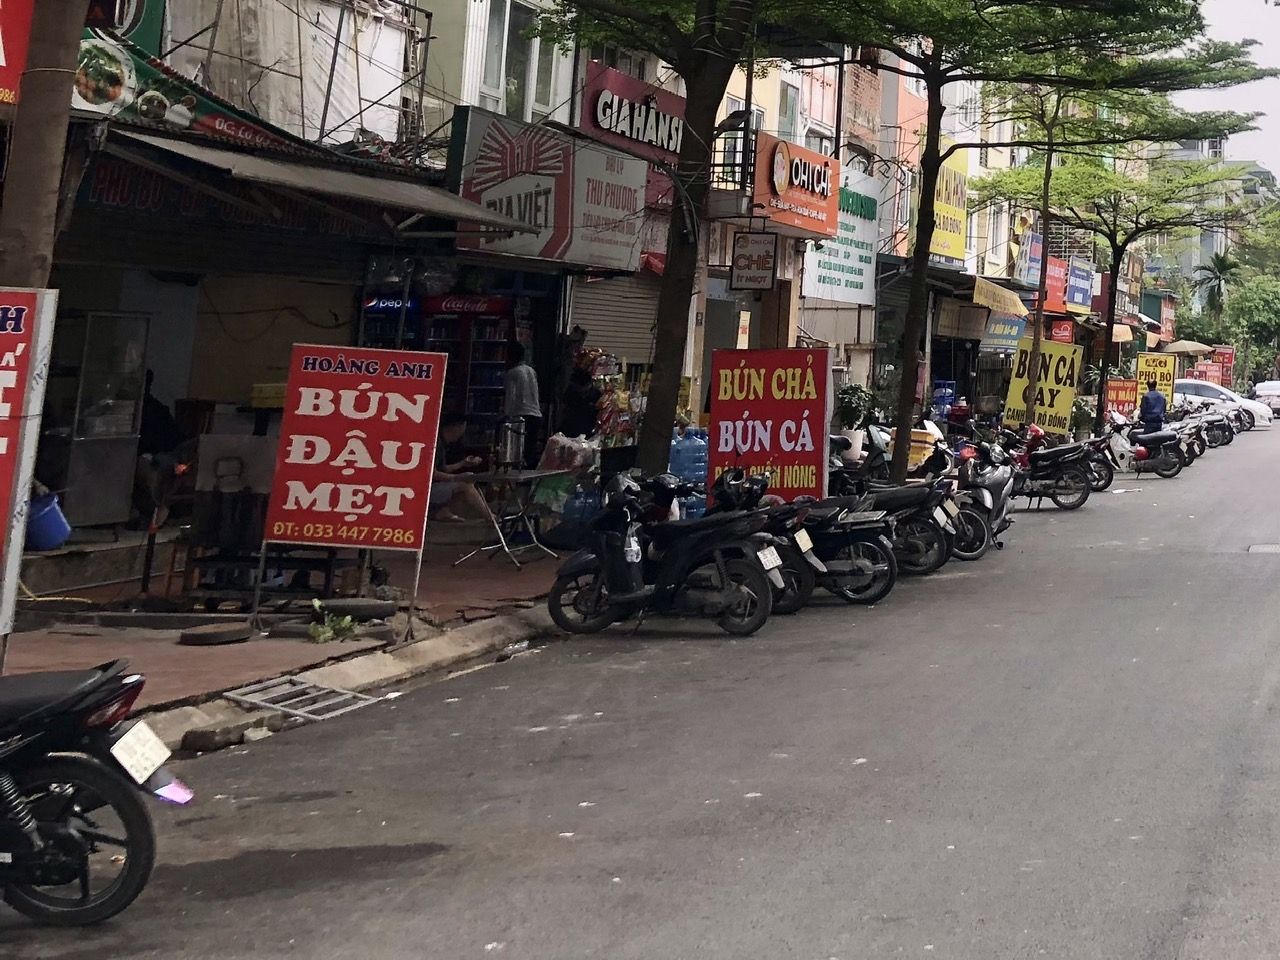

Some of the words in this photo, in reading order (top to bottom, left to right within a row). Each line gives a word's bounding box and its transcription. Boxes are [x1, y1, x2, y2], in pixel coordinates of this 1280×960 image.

[586, 177, 603, 206] THU
[379, 299, 411, 312] pepi
[302, 354, 380, 376] HOÀNG
[384, 362, 434, 379] ANH
[718, 360, 766, 400] BÚN
[771, 354, 817, 400] CHẢ
[1055, 349, 1078, 387] CÁ
[295, 382, 430, 423] BÚN
[718, 410, 773, 453] BÚN
[779, 409, 814, 453] CÁ
[284, 430, 426, 475] ĐẬU
[784, 461, 817, 489] NÓNG
[282, 480, 415, 522] MẸT
[273, 522, 300, 536] ĐT:
[303, 523, 334, 538] 033
[374, 527, 415, 544] 7986
